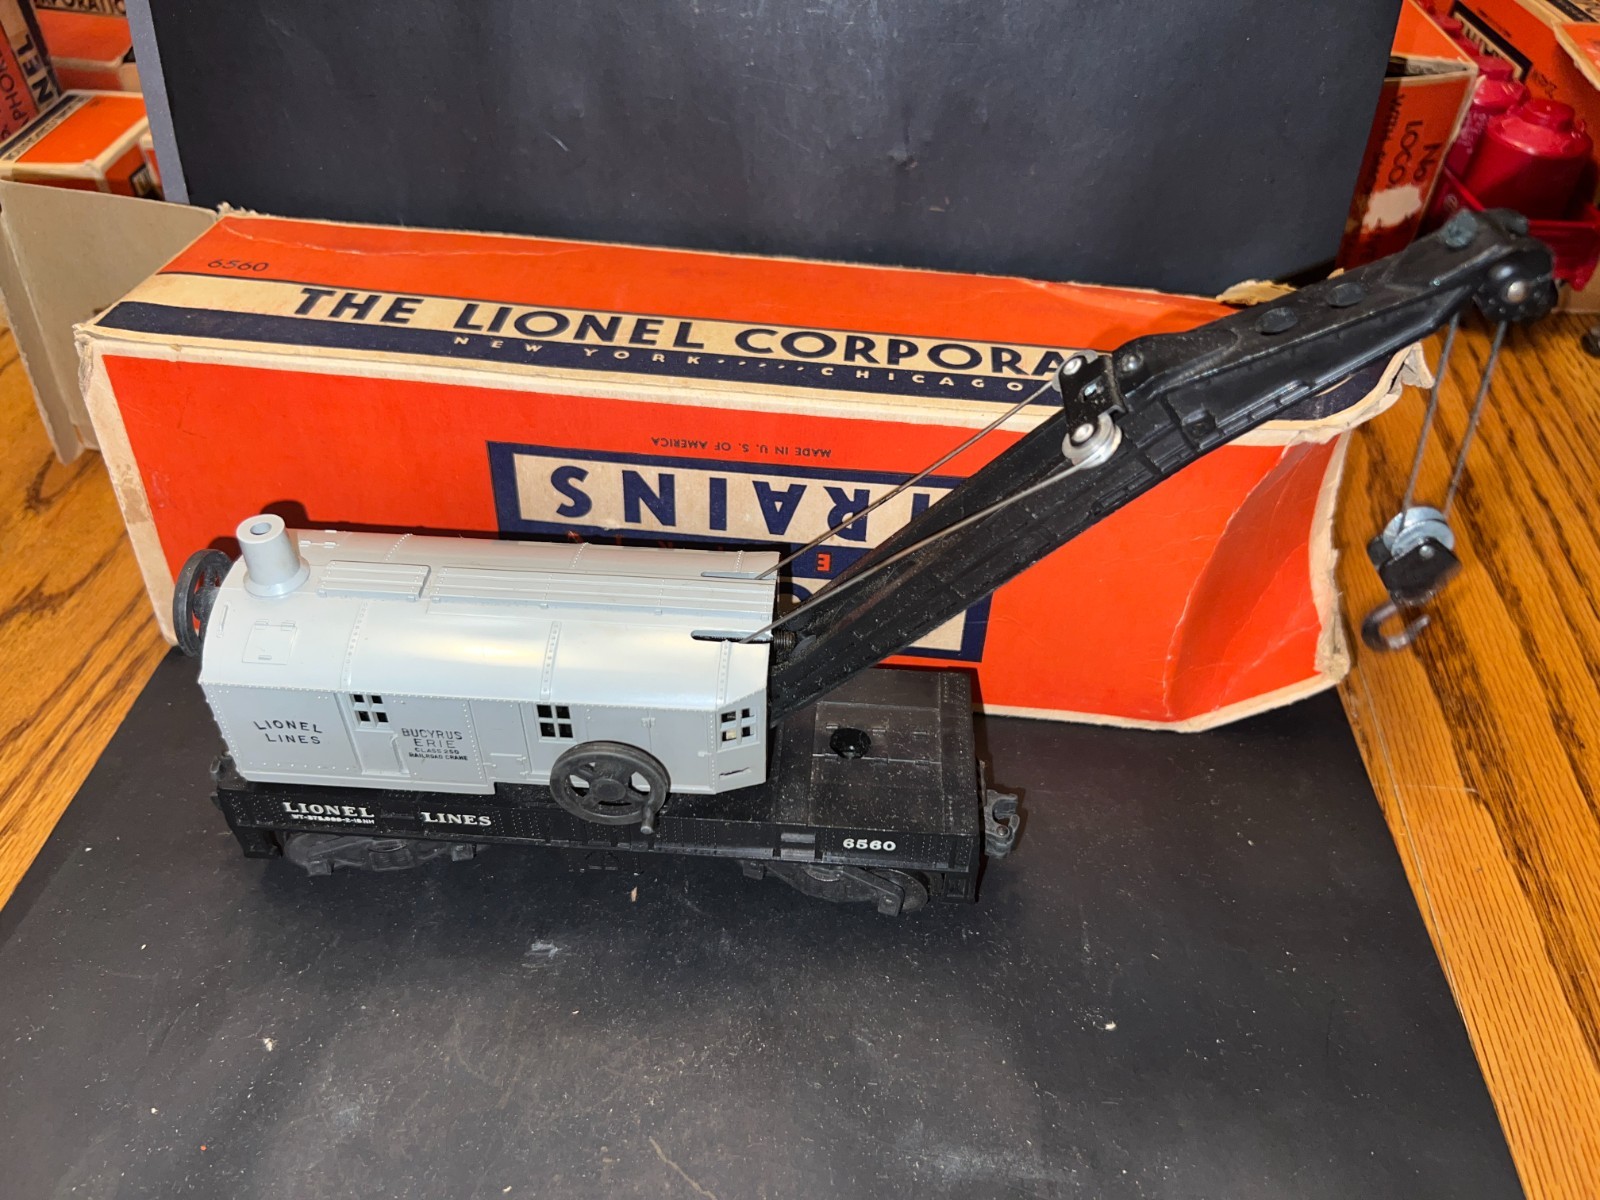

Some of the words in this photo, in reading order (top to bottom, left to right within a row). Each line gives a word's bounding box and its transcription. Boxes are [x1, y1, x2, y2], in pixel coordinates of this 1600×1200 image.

[208, 259, 269, 272] 6560
[295, 287, 426, 324] THE
[453, 303, 705, 349] LIONEL
[454, 337, 543, 353] NEW
[584, 348, 700, 365] YORK
[821, 367, 1024, 391] CHICAGO
[651, 437, 708, 449] AMERICA
[714, 442, 731, 451] OF
[739, 443, 749, 453] S.
[756, 444, 769, 454] U.
[775, 446, 789, 455] IN
[795, 447, 832, 458] MADE
[253, 719, 323, 734] LIONEL
[265, 733, 321, 745] LINES
[401, 728, 463, 740] BUCYRUS
[413, 738, 456, 749] ERIE
[408, 751, 444, 760] RAILROAD
[283, 801, 376, 818] LIONEL
[420, 811, 492, 826] LINES
[842, 837, 897, 851] 6560
